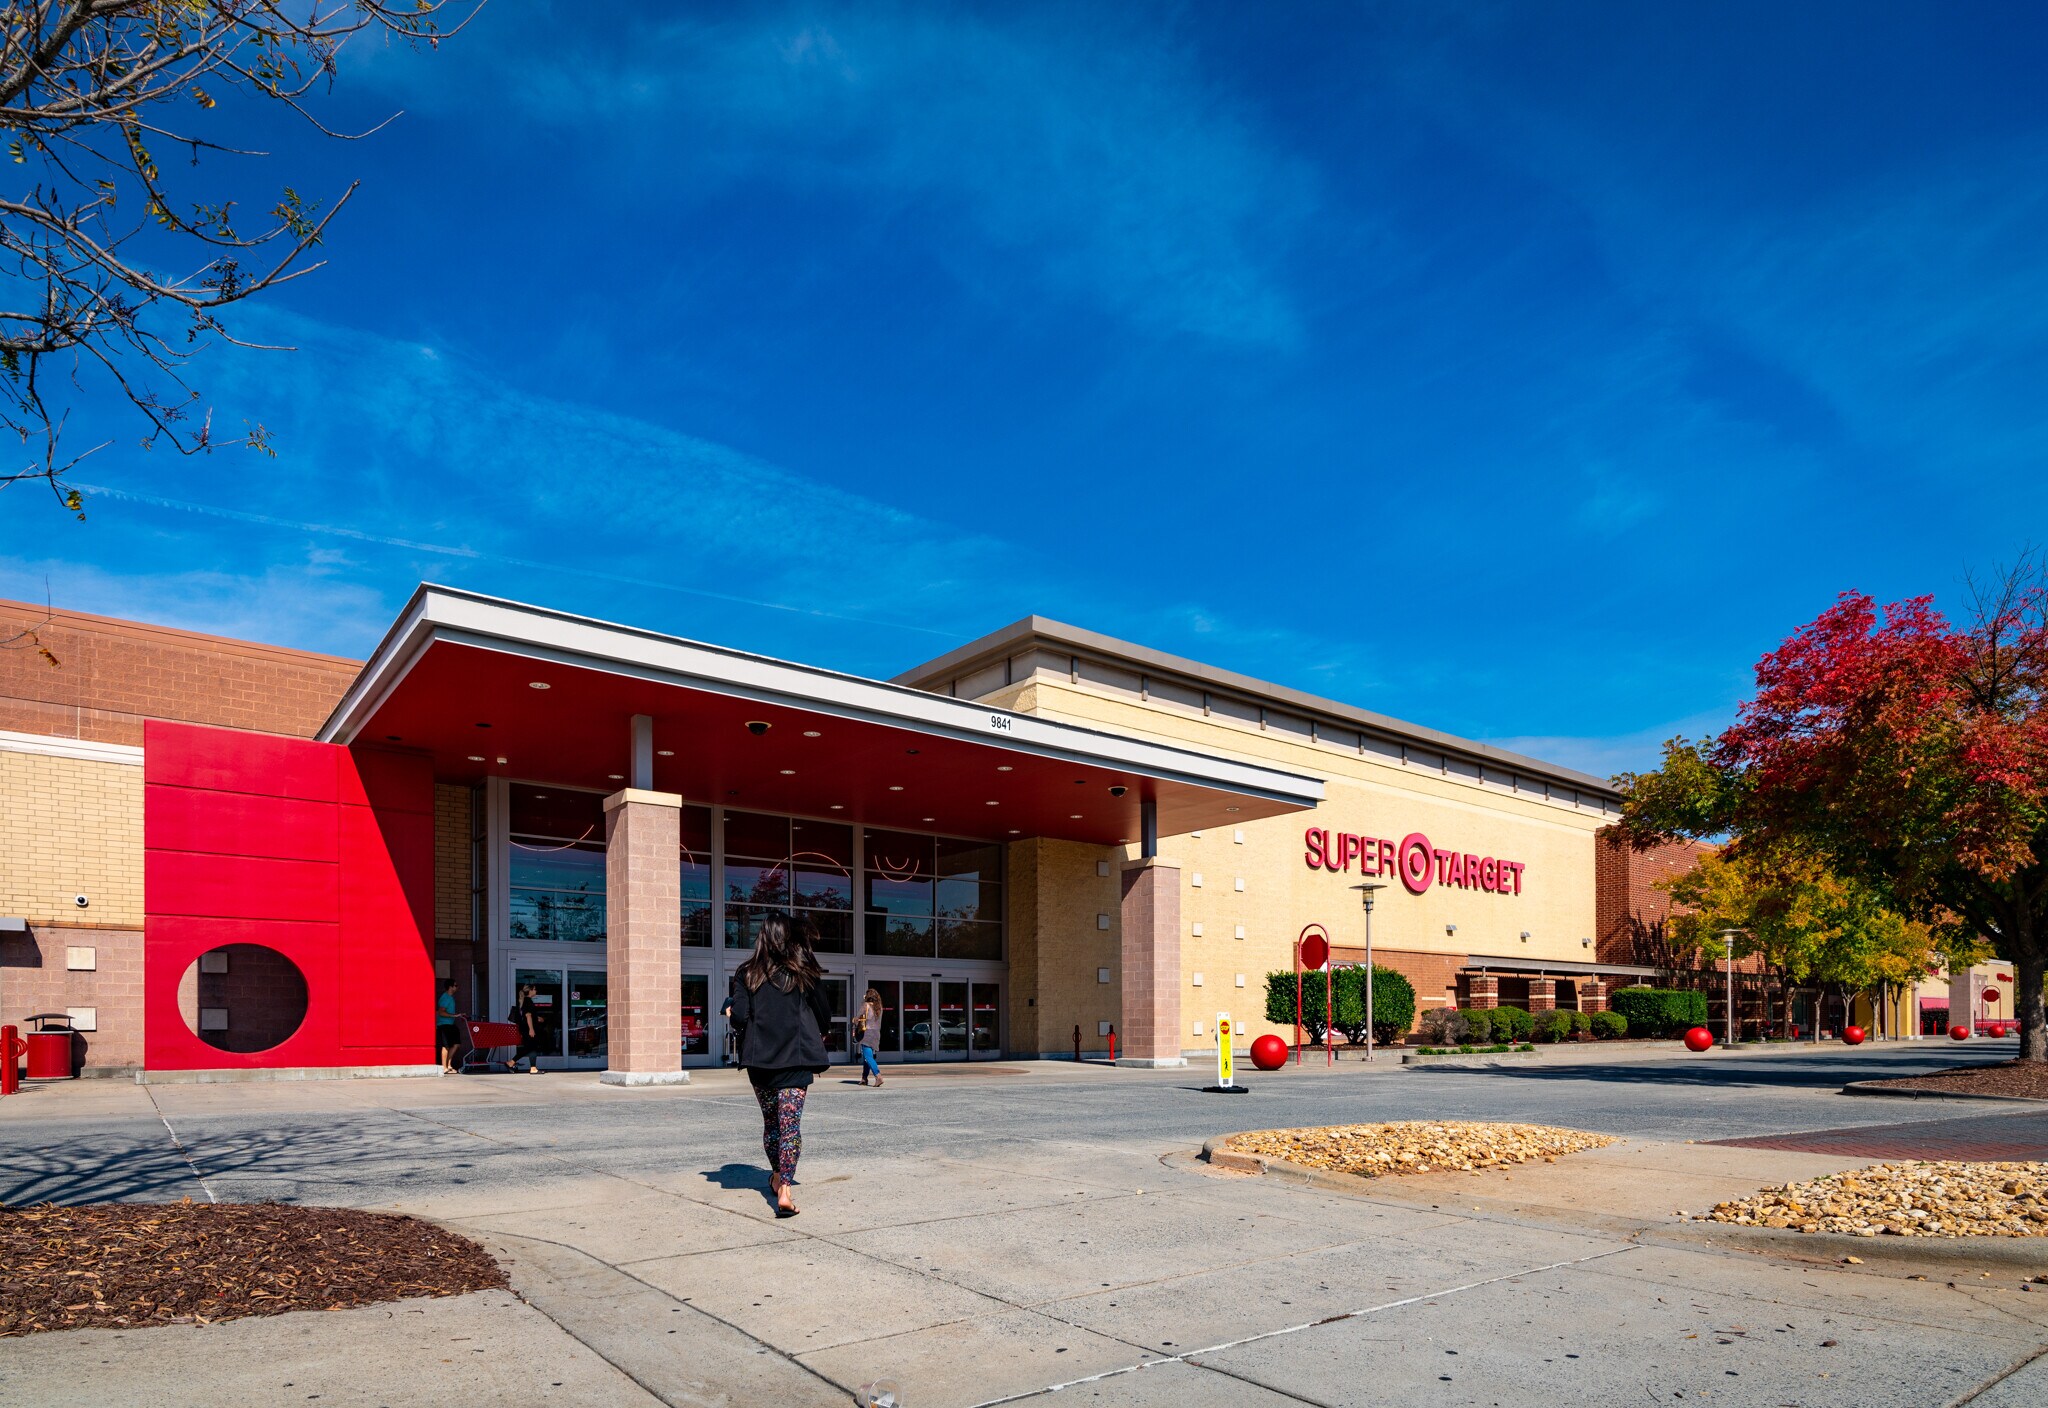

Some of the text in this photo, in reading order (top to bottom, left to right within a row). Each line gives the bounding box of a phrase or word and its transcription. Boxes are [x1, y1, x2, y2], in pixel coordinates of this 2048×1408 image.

[991, 715, 1011, 731] 9841
[1305, 827, 1526, 894] SUPER TARGET
